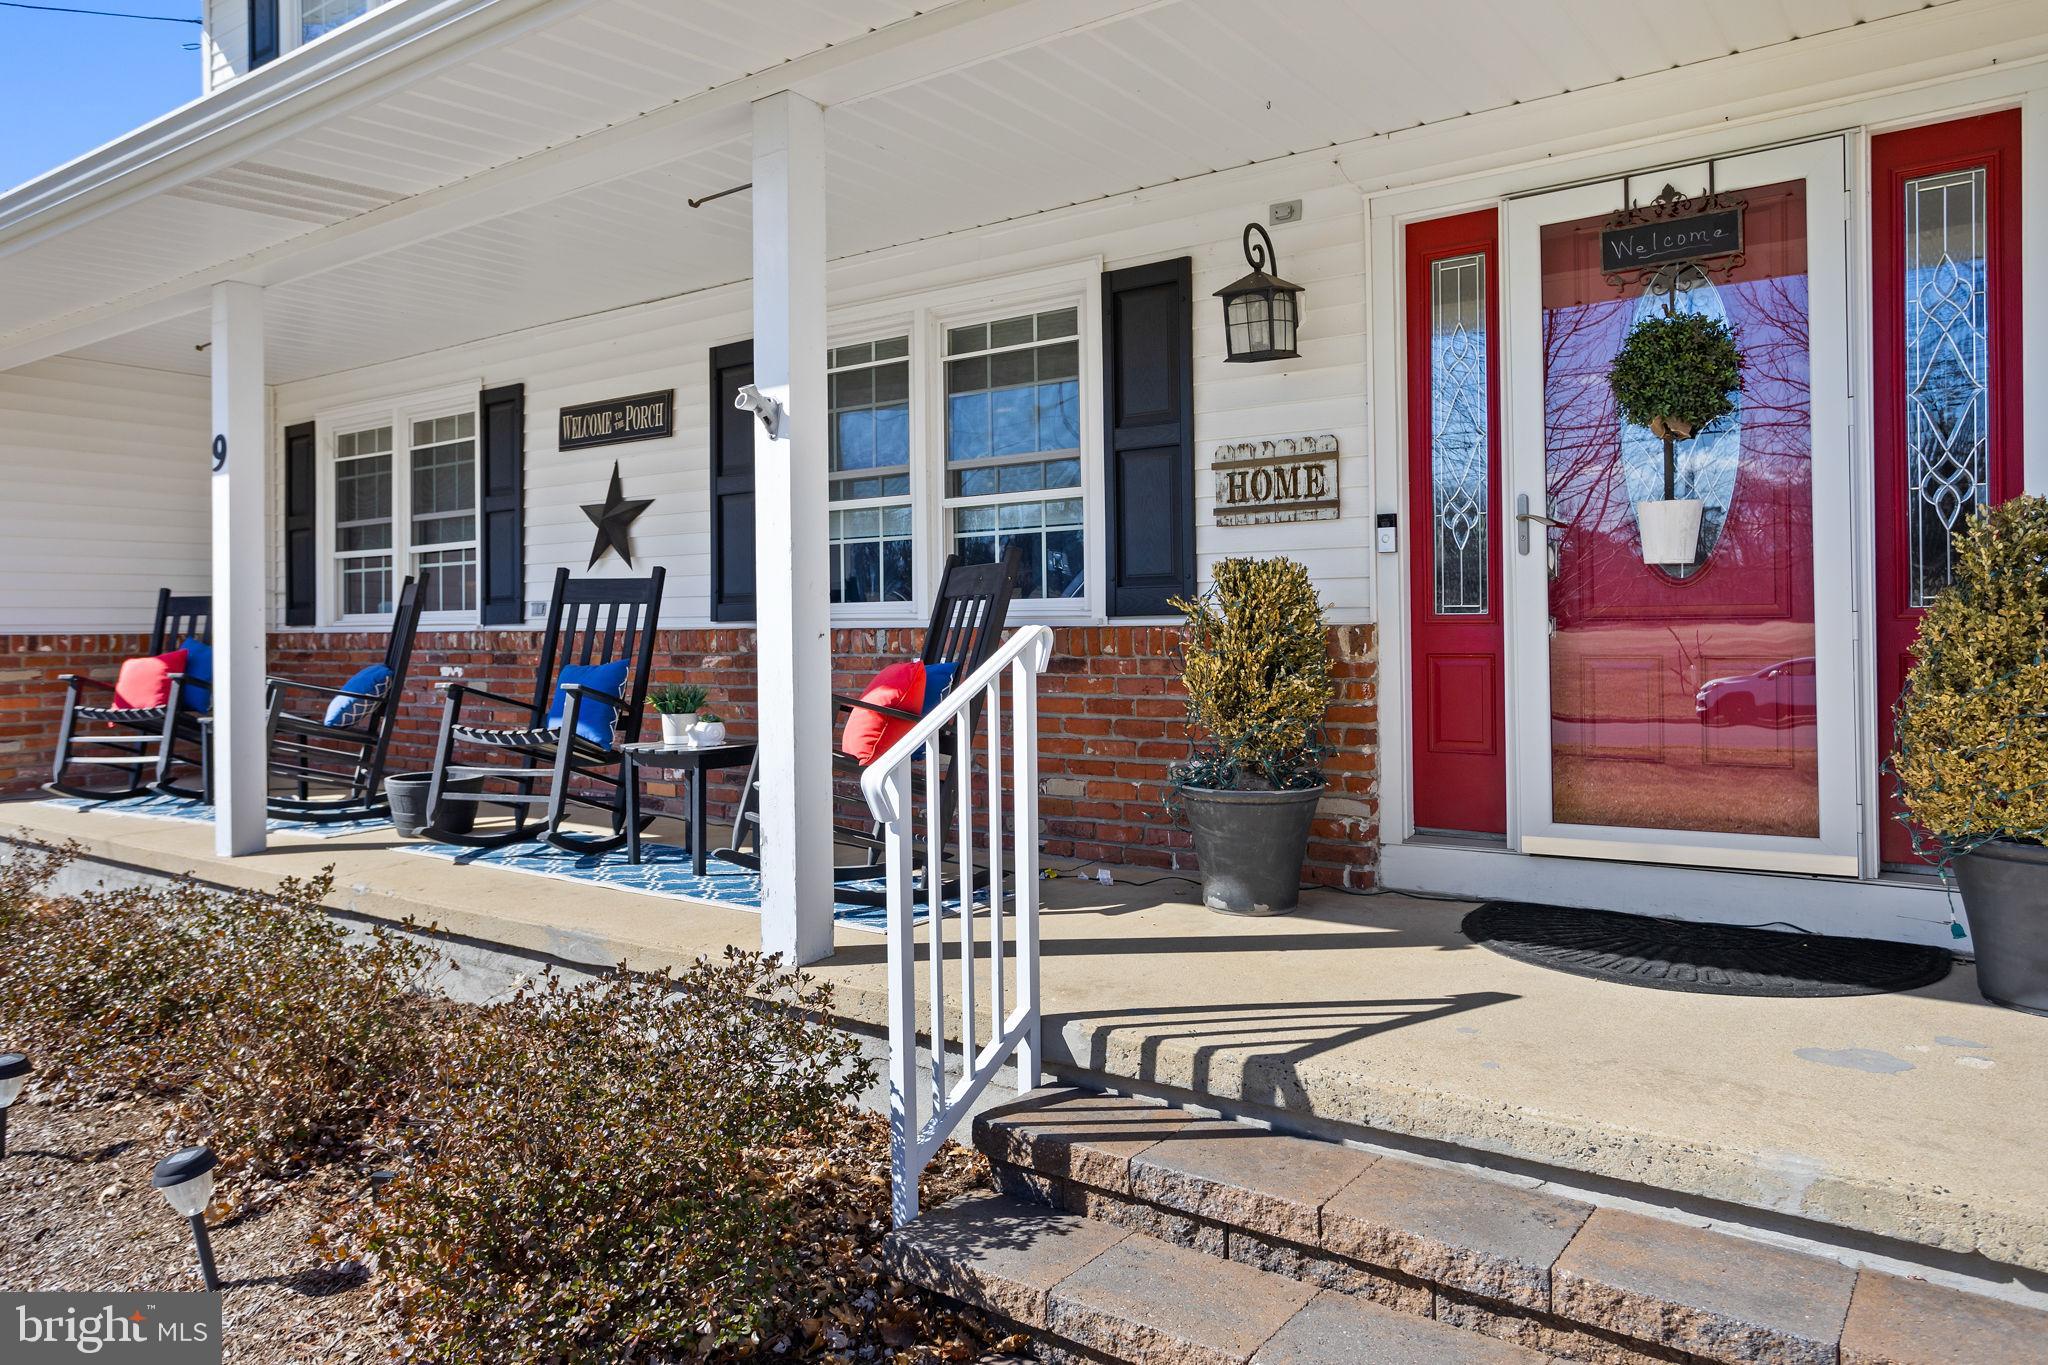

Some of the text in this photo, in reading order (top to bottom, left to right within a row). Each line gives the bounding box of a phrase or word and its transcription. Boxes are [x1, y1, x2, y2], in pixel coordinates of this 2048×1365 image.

[1610, 227, 1730, 259] Welcome
[562, 411, 612, 440] WELCOME
[625, 402, 665, 432] PORCH
[212, 434, 227, 472] 9
[1226, 463, 1326, 504] HOME
